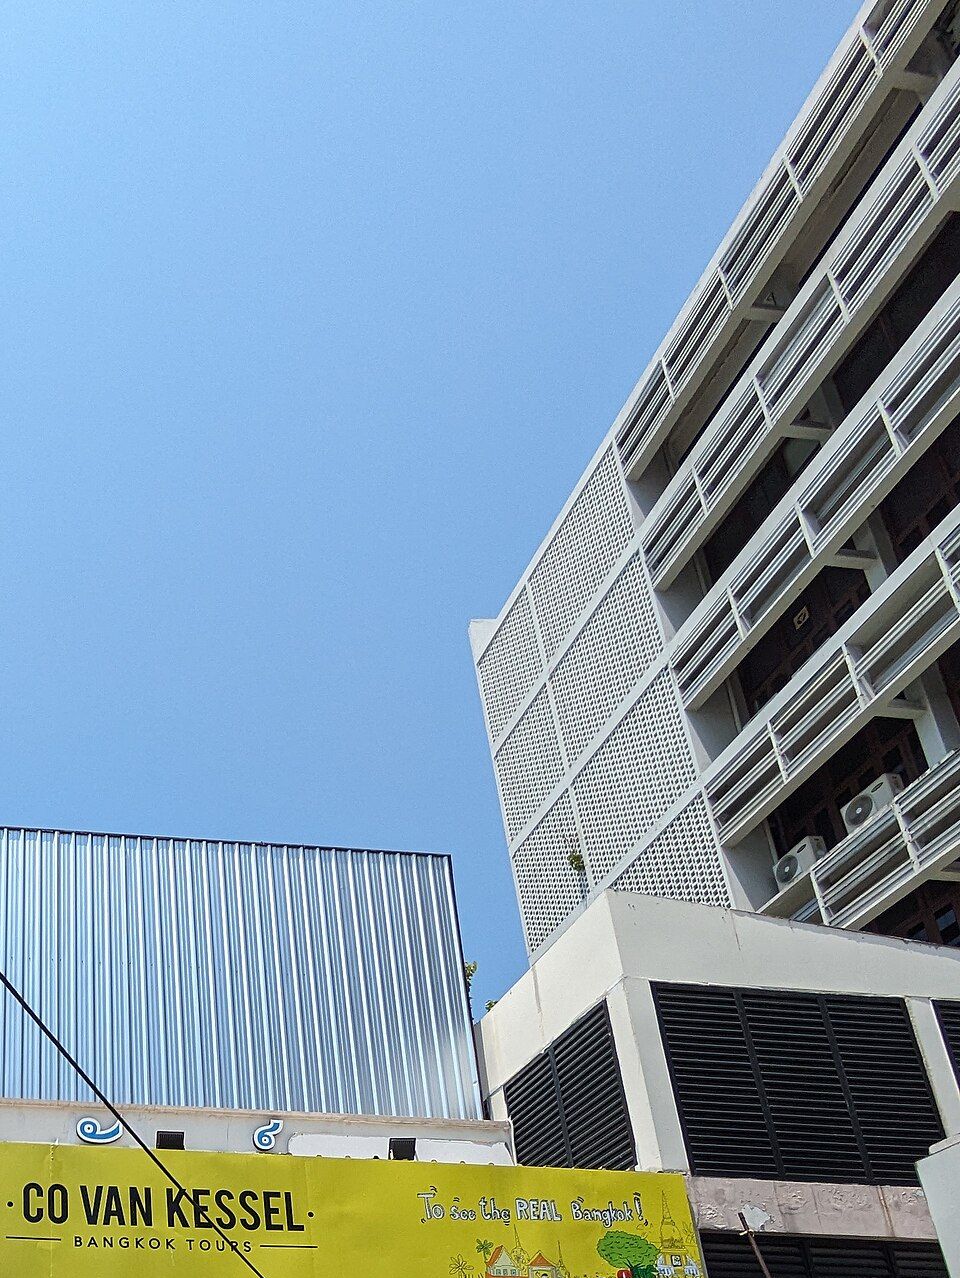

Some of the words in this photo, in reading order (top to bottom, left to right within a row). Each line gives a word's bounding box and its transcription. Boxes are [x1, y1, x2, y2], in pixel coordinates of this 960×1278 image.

[23, 1183, 68, 1224] CO
[79, 1184, 153, 1228] VAN
[167, 1187, 305, 1232] KESSEL
[417, 1192, 445, 1219] To
[450, 1204, 476, 1220] see
[479, 1197, 510, 1221] the
[515, 1198, 562, 1221] REAL
[73, 1235, 176, 1250] BANGKOK
[186, 1238, 253, 1253] TOURS
